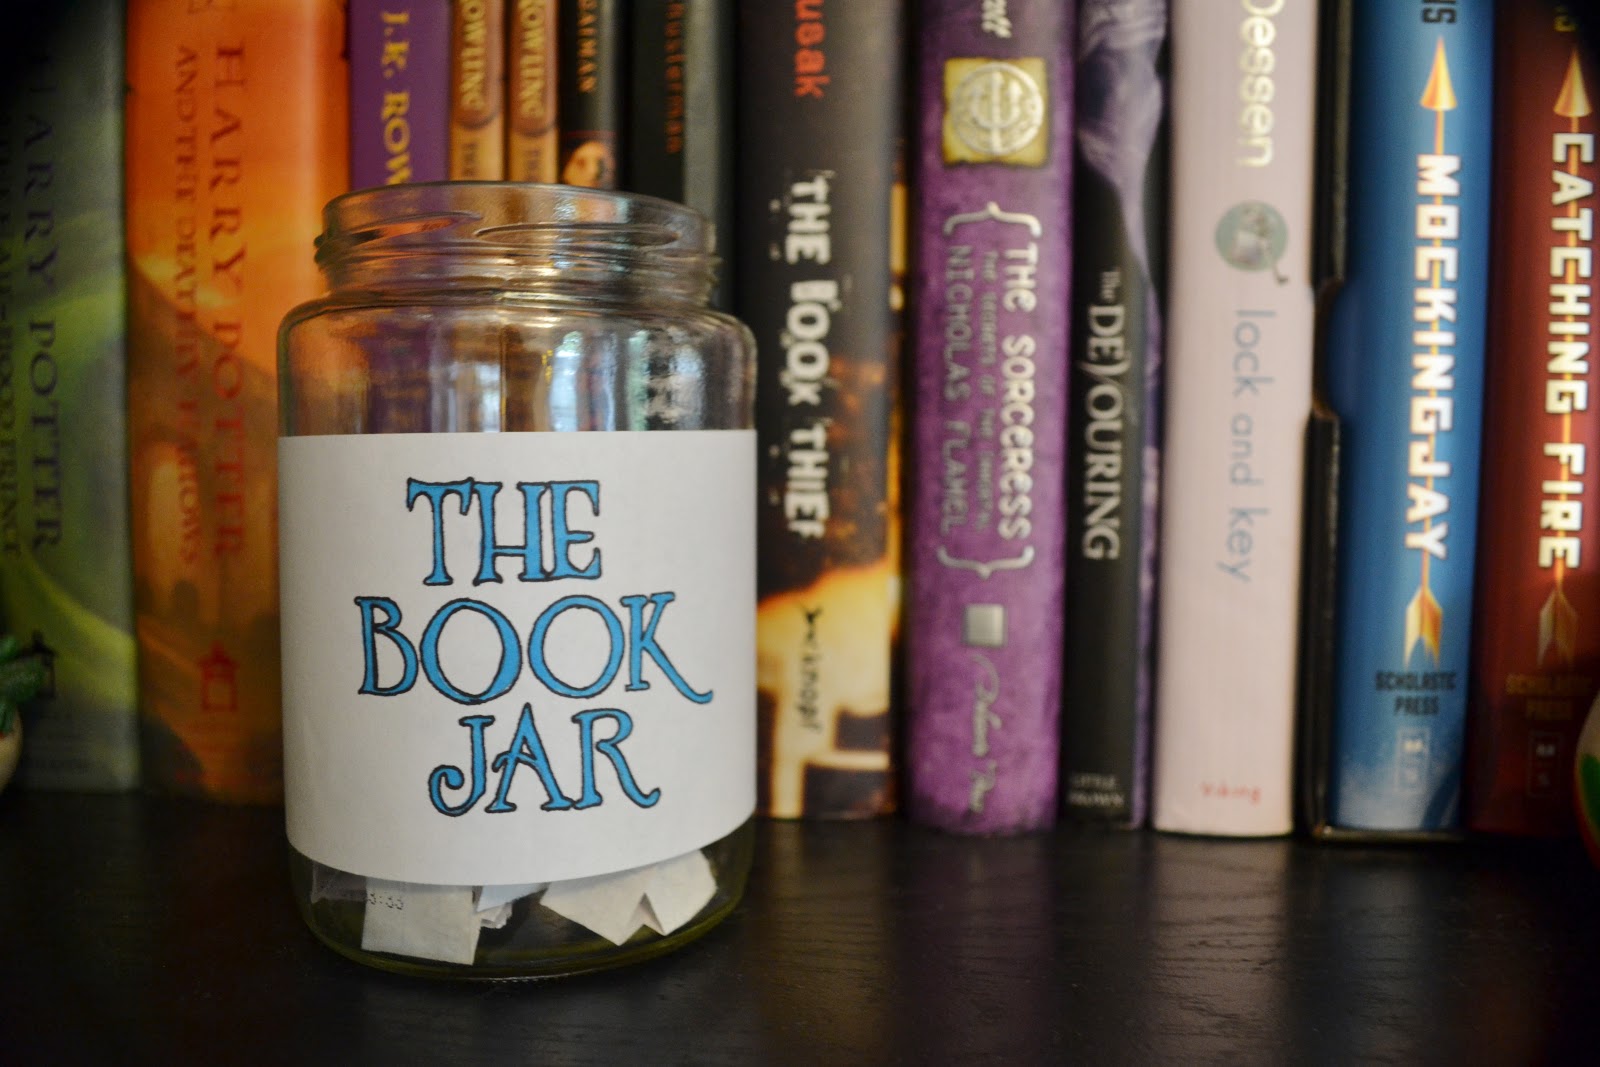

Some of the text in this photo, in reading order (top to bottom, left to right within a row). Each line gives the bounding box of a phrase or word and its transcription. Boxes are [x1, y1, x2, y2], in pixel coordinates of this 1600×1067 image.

[27, 320, 62, 551] POTTER
[210, 44, 247, 557] HARRY POTTER
[784, 176, 836, 540] THE BOOK THIEF
[939, 244, 975, 538] NICHOLAS FLAMEL
[1404, 154, 1461, 560] MOCKINGJAY
[1538, 133, 1595, 569] CATCHING FIRE
[406, 477, 602, 586] THE
[1217, 309, 1278, 582] lock and key
[354, 592, 714, 705] BOOK
[428, 702, 661, 817] JAR
